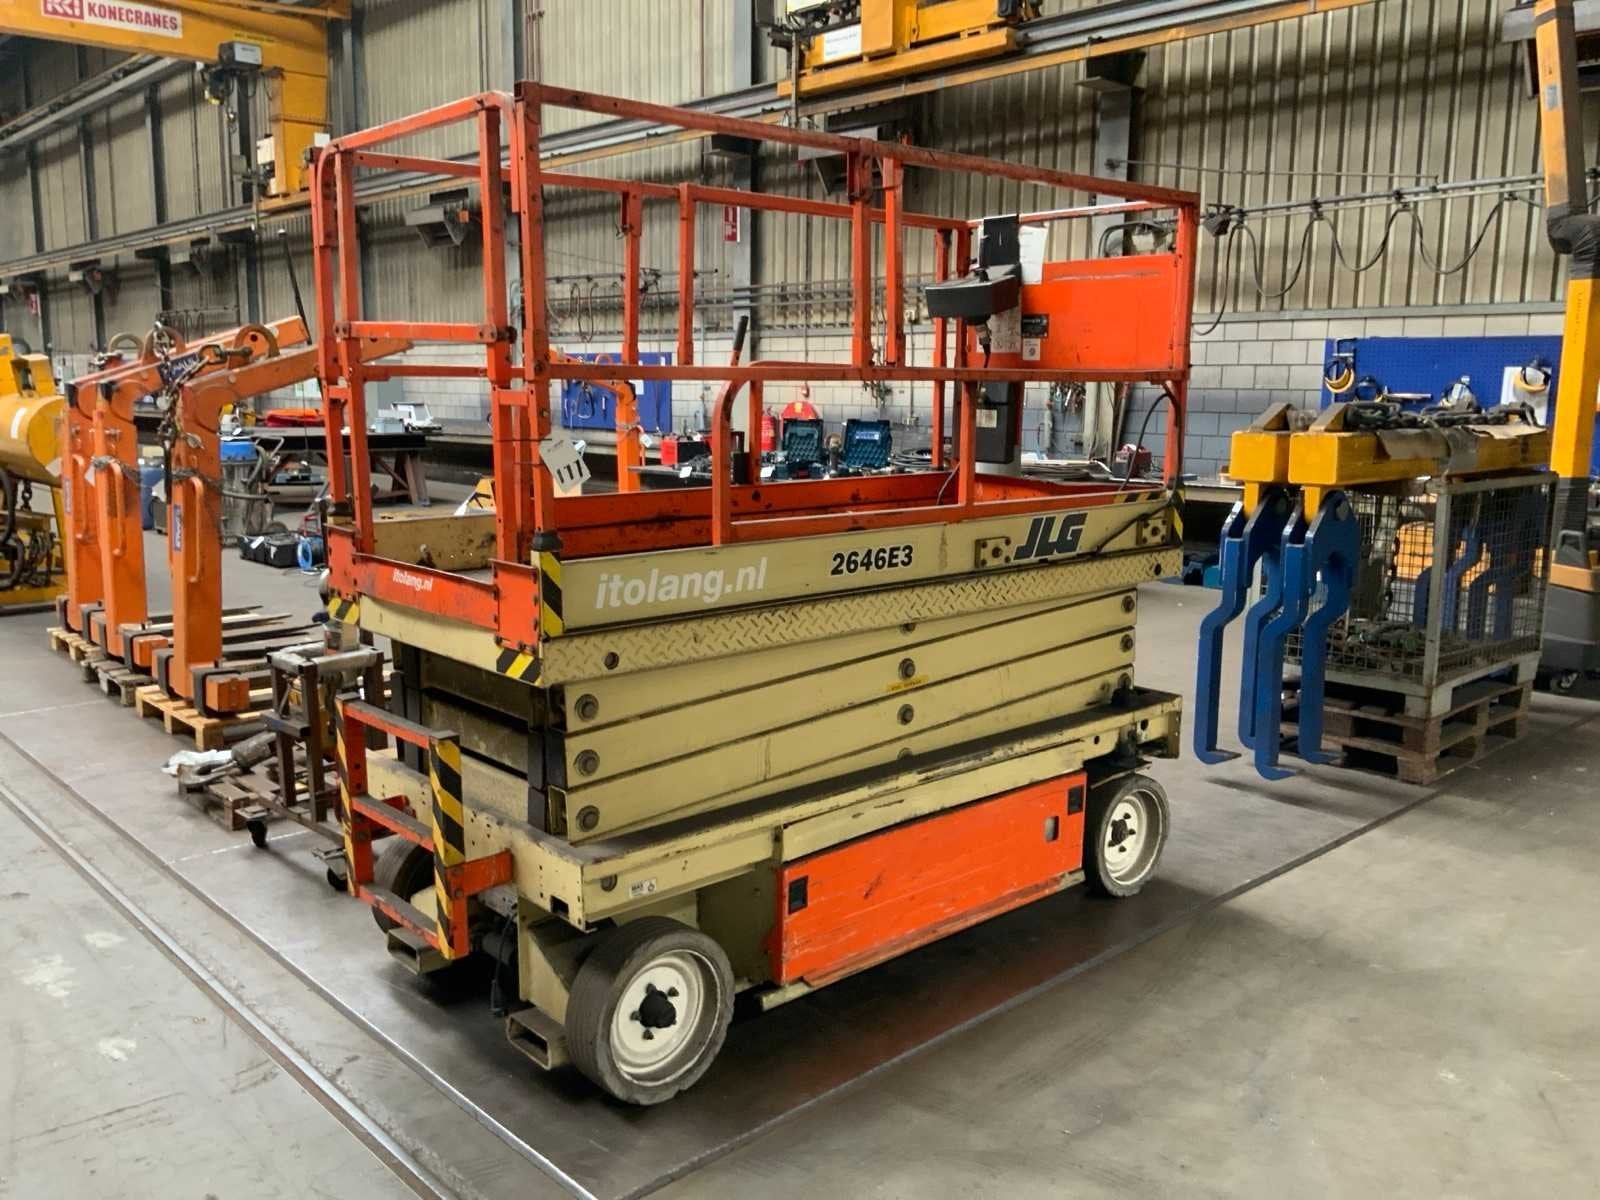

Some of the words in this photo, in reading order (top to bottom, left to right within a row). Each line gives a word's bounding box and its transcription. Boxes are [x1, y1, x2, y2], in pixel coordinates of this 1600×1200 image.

[87, 3, 178, 31] KONECRANES
[1013, 512, 1089, 561] JLG
[830, 544, 914, 576] 2646E3
[594, 556, 768, 610] itolang.nl
